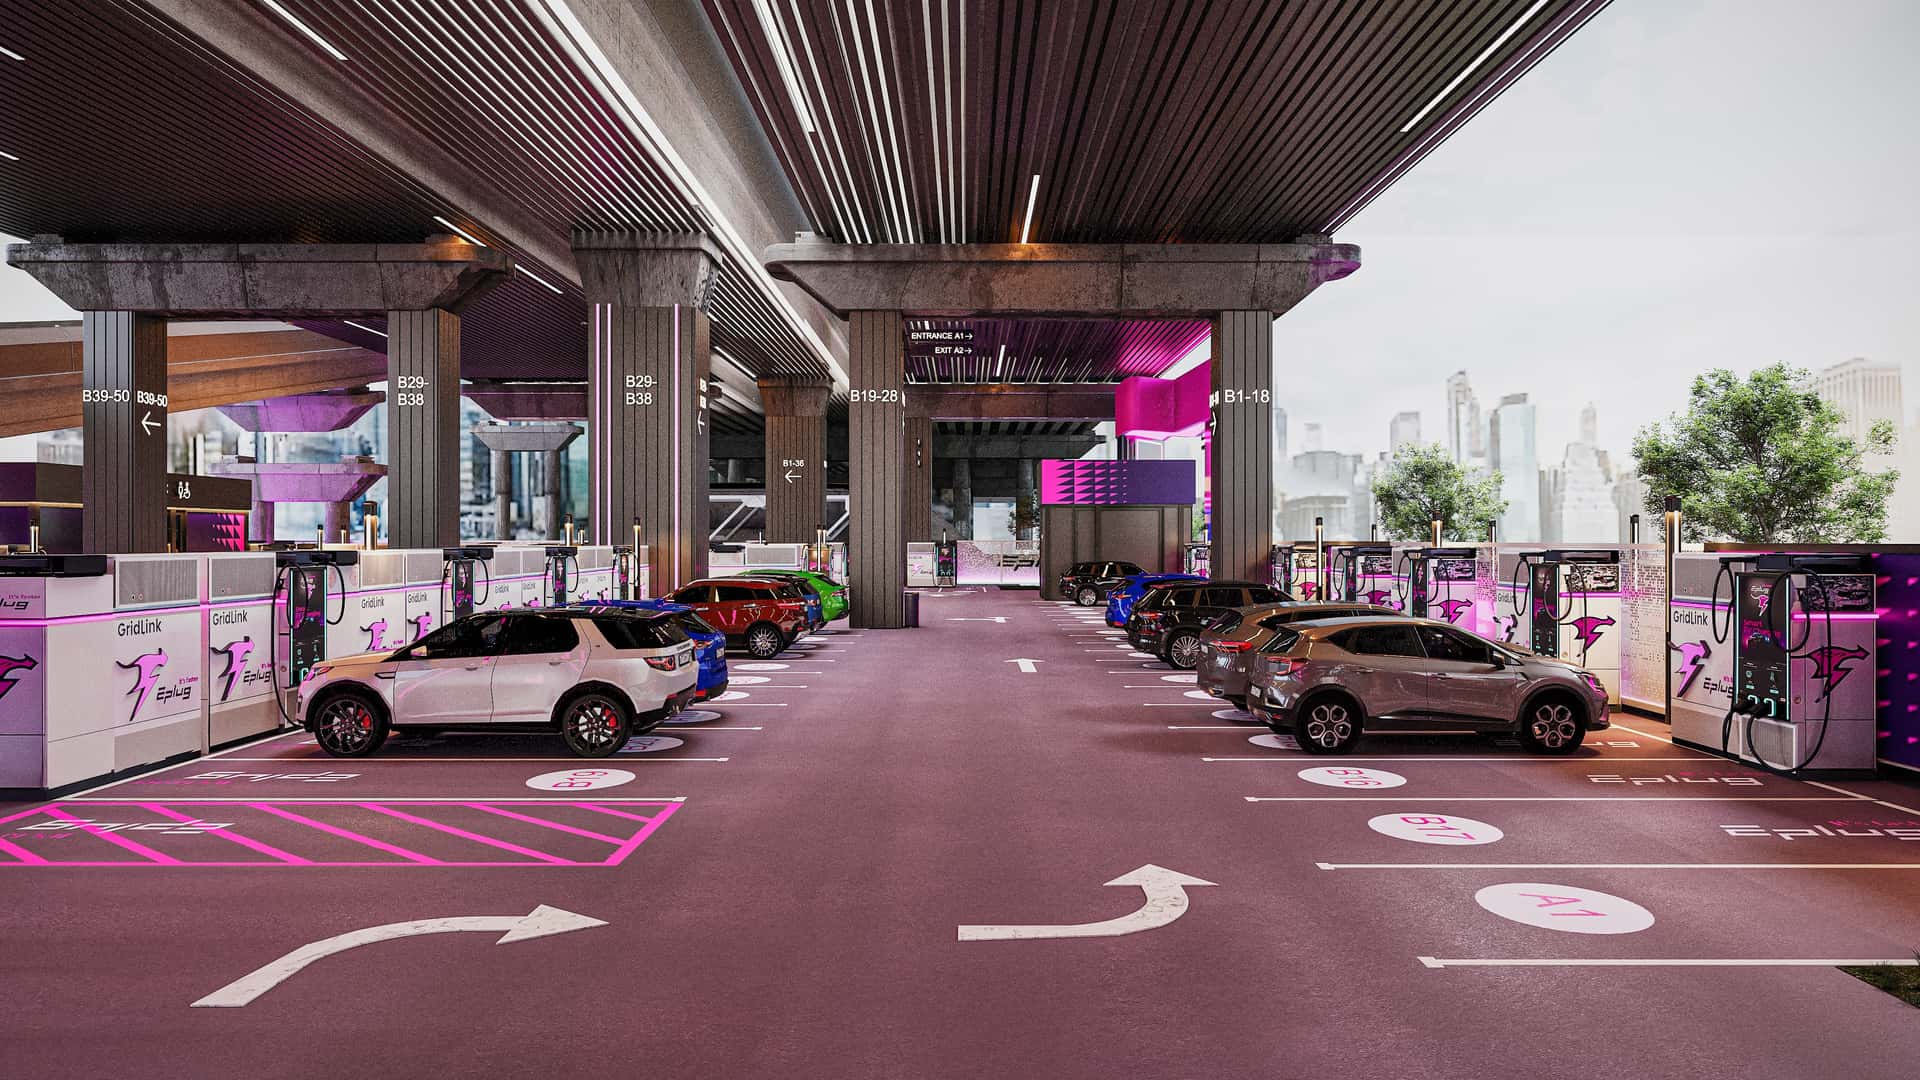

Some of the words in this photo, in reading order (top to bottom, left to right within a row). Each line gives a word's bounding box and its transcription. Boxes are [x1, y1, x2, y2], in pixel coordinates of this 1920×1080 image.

[911, 332, 953, 340] ENTRANCE
[954, 332, 964, 340] A1
[935, 346, 953, 354] EXIT
[953, 346, 964, 354] A2
[398, 375, 430, 389] B29-
[625, 375, 658, 388] B29-
[82, 389, 130, 402] B39-50
[136, 390, 168, 408] B39-50
[397, 392, 424, 406] B38
[625, 392, 653, 405] B38
[850, 389, 898, 402] B19-28
[1224, 389, 1270, 404] B1-18
[997, 555, 1040, 572] Epl
[0, 598, 29, 611] lug
[361, 597, 385, 609] GridLink
[212, 609, 249, 626] GridLink
[1673, 610, 1709, 627] GridLink
[117, 618, 163, 637] GridLink
[243, 669, 272, 686] Eplug
[156, 685, 192, 704] Eplug
[1703, 676, 1734, 699] Eplug
[552, 770, 609, 789] B19
[1326, 768, 1382, 787] B16
[1586, 774, 1764, 786] Eplug
[1400, 815, 1477, 841] B17
[1719, 824, 1920, 841] Eplug
[1518, 892, 1608, 917] A1
